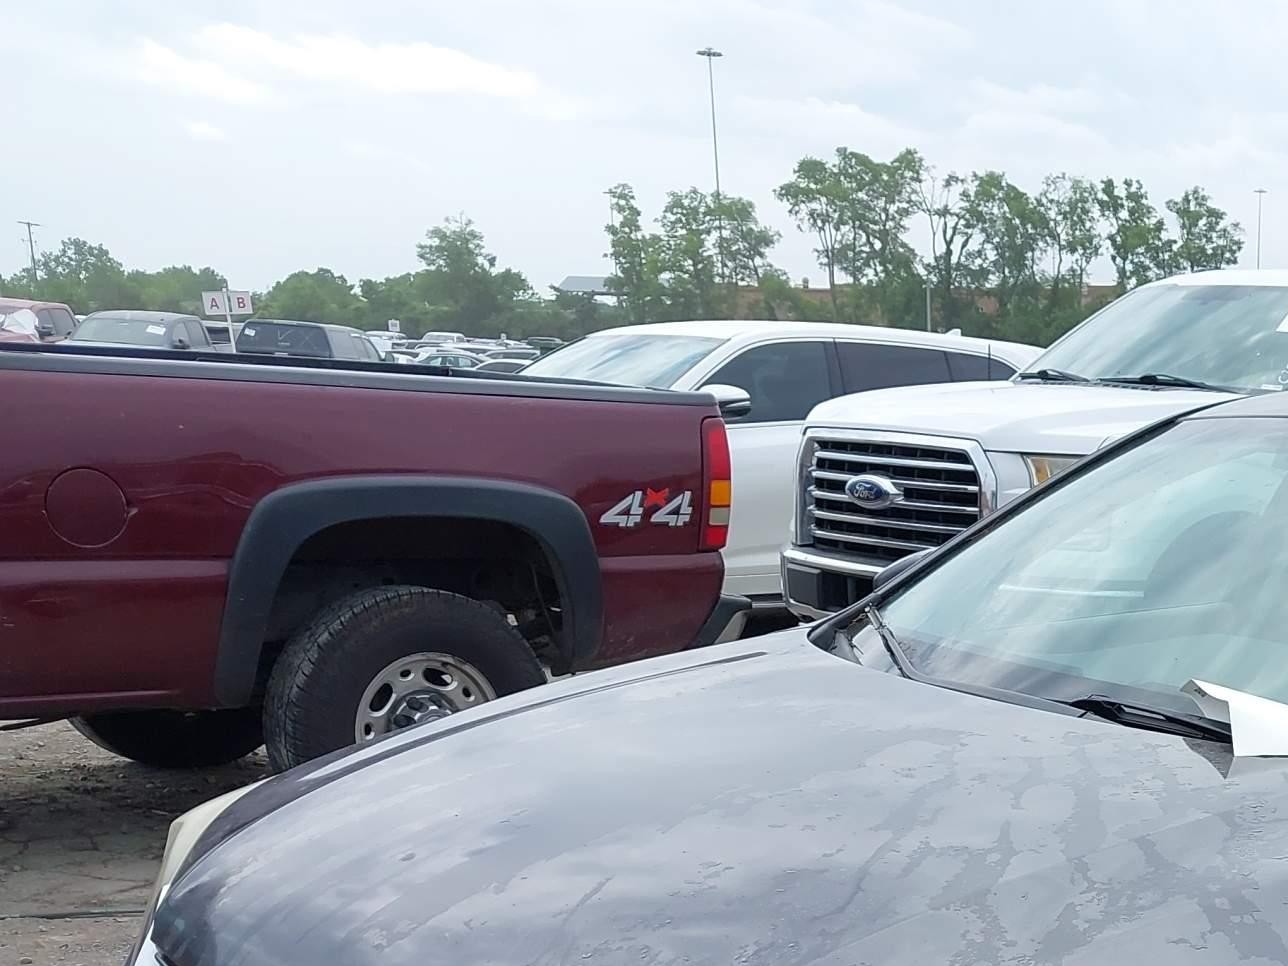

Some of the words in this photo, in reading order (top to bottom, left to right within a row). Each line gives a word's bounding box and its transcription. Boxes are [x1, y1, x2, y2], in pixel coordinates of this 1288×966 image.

[210, 297, 219, 310] A
[236, 297, 246, 309] B
[853, 482, 877, 500] Ford
